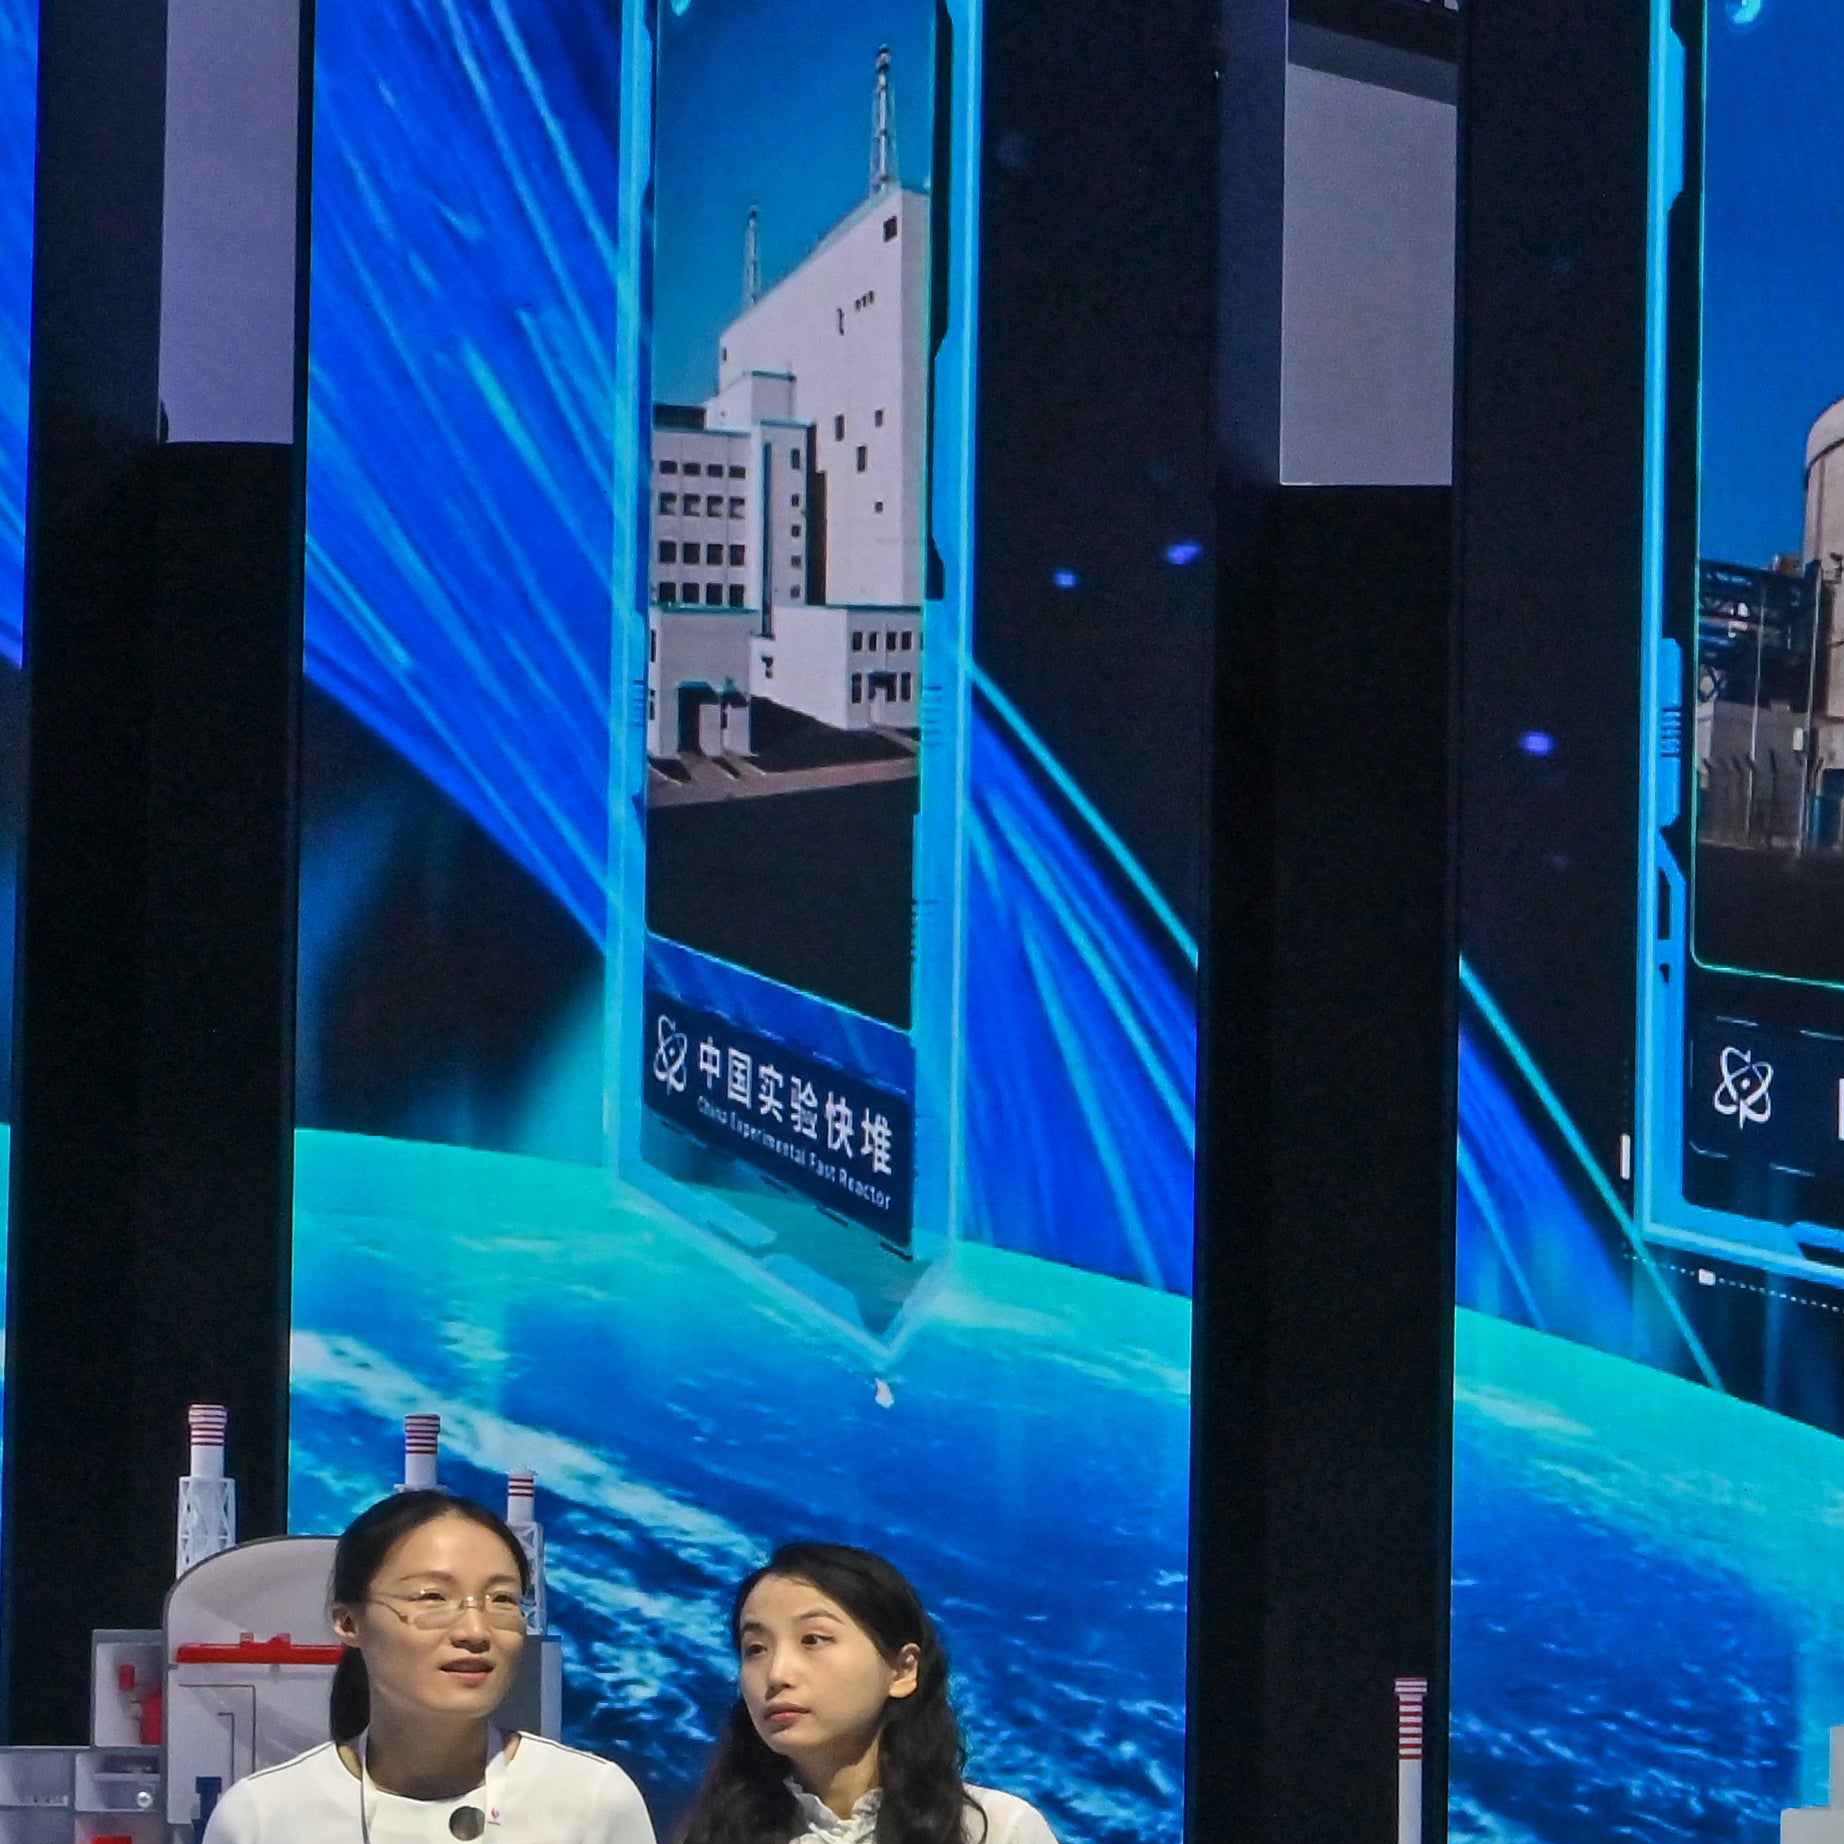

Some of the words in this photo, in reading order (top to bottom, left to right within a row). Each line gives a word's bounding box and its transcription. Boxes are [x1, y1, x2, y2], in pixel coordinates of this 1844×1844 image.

[697, 1095, 729, 1127] China
[729, 1112, 807, 1168] Experimental
[809, 1151, 836, 1186] Fast
[839, 1163, 892, 1211] Reactor
[698, 1036, 893, 1176] 中国实验快堆
